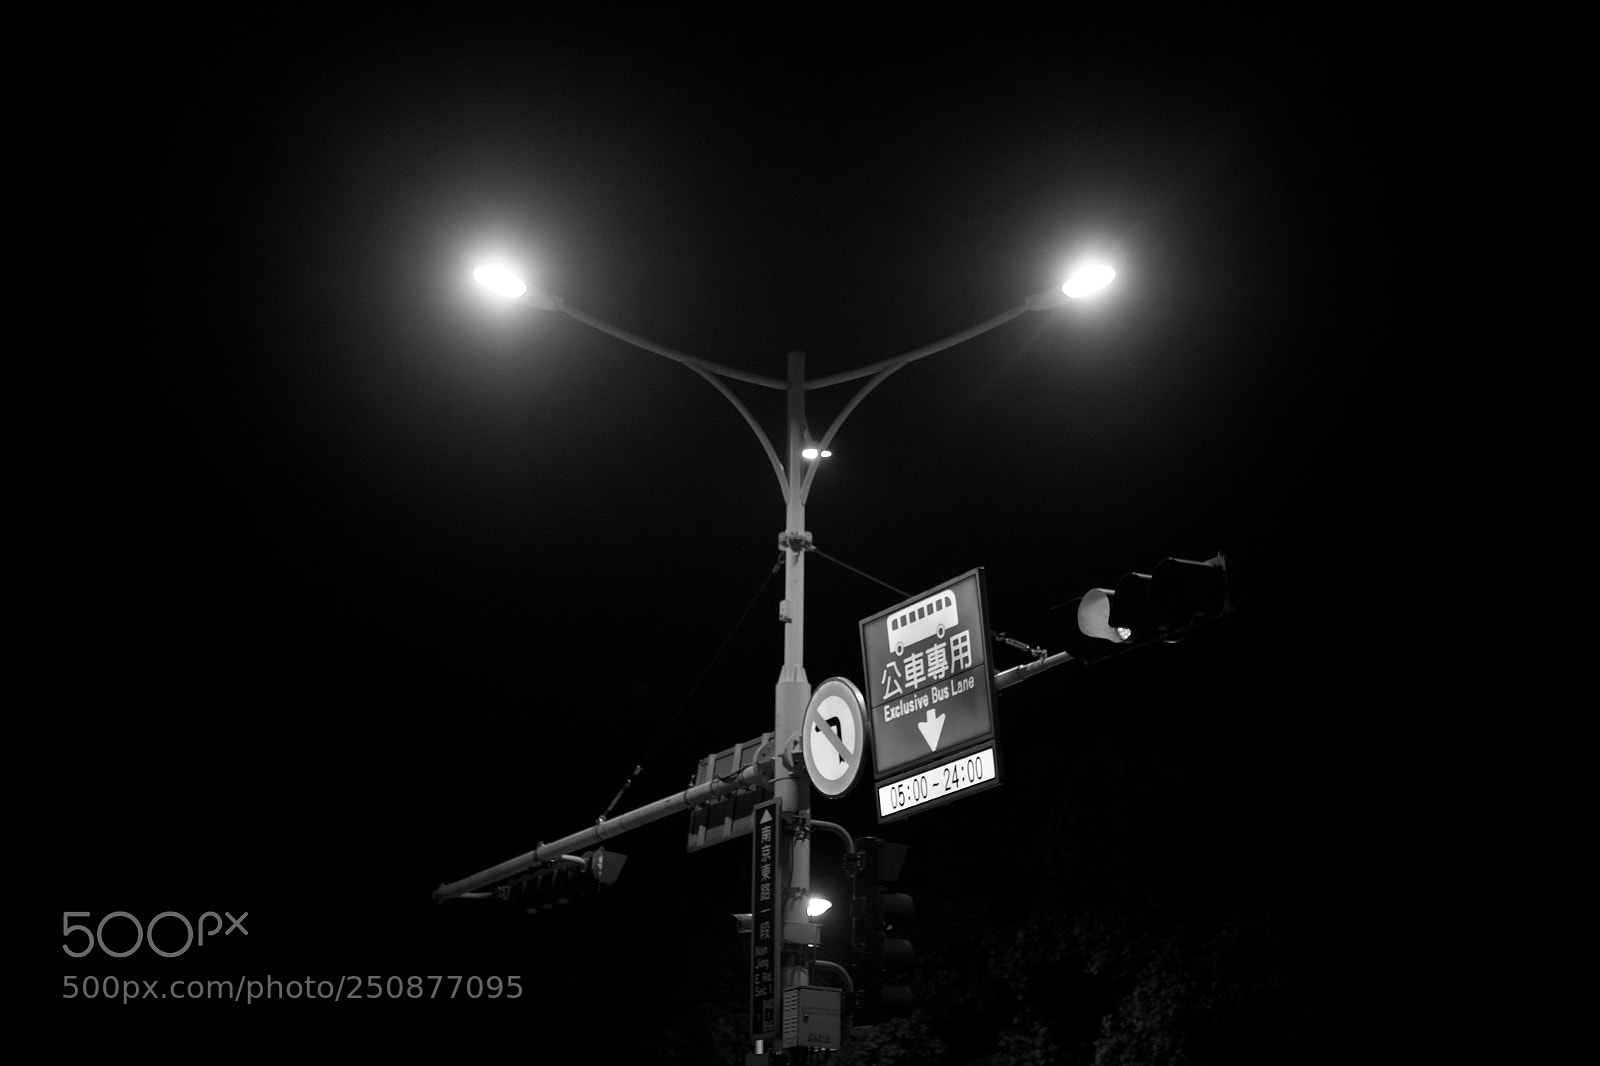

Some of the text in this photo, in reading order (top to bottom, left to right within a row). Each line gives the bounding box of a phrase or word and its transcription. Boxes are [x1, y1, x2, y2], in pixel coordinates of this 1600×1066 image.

[881, 630, 972, 700] 公車專用
[883, 676, 975, 722] Exclusive Bus Lane
